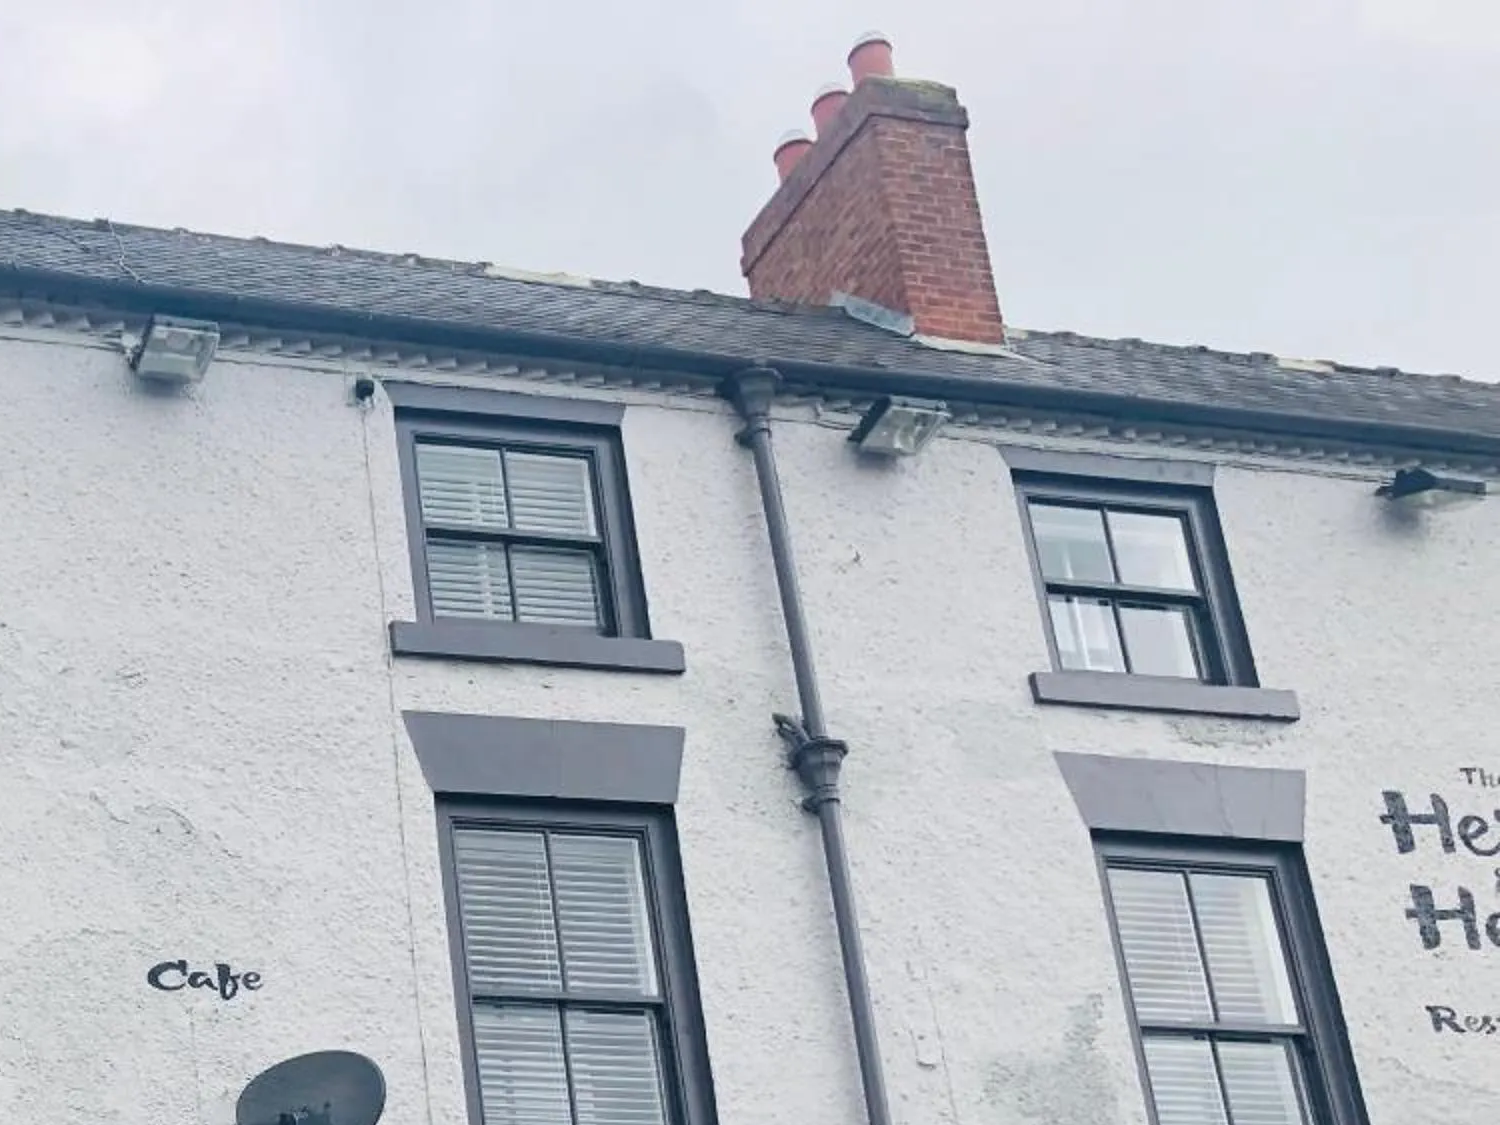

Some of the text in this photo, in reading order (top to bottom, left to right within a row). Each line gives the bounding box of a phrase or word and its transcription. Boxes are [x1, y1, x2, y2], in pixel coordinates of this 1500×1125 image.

[1458, 766, 1500, 790] Th
[1378, 790, 1500, 858] He
[146, 959, 263, 1001] Cafe
[1424, 1004, 1500, 1035] Res
